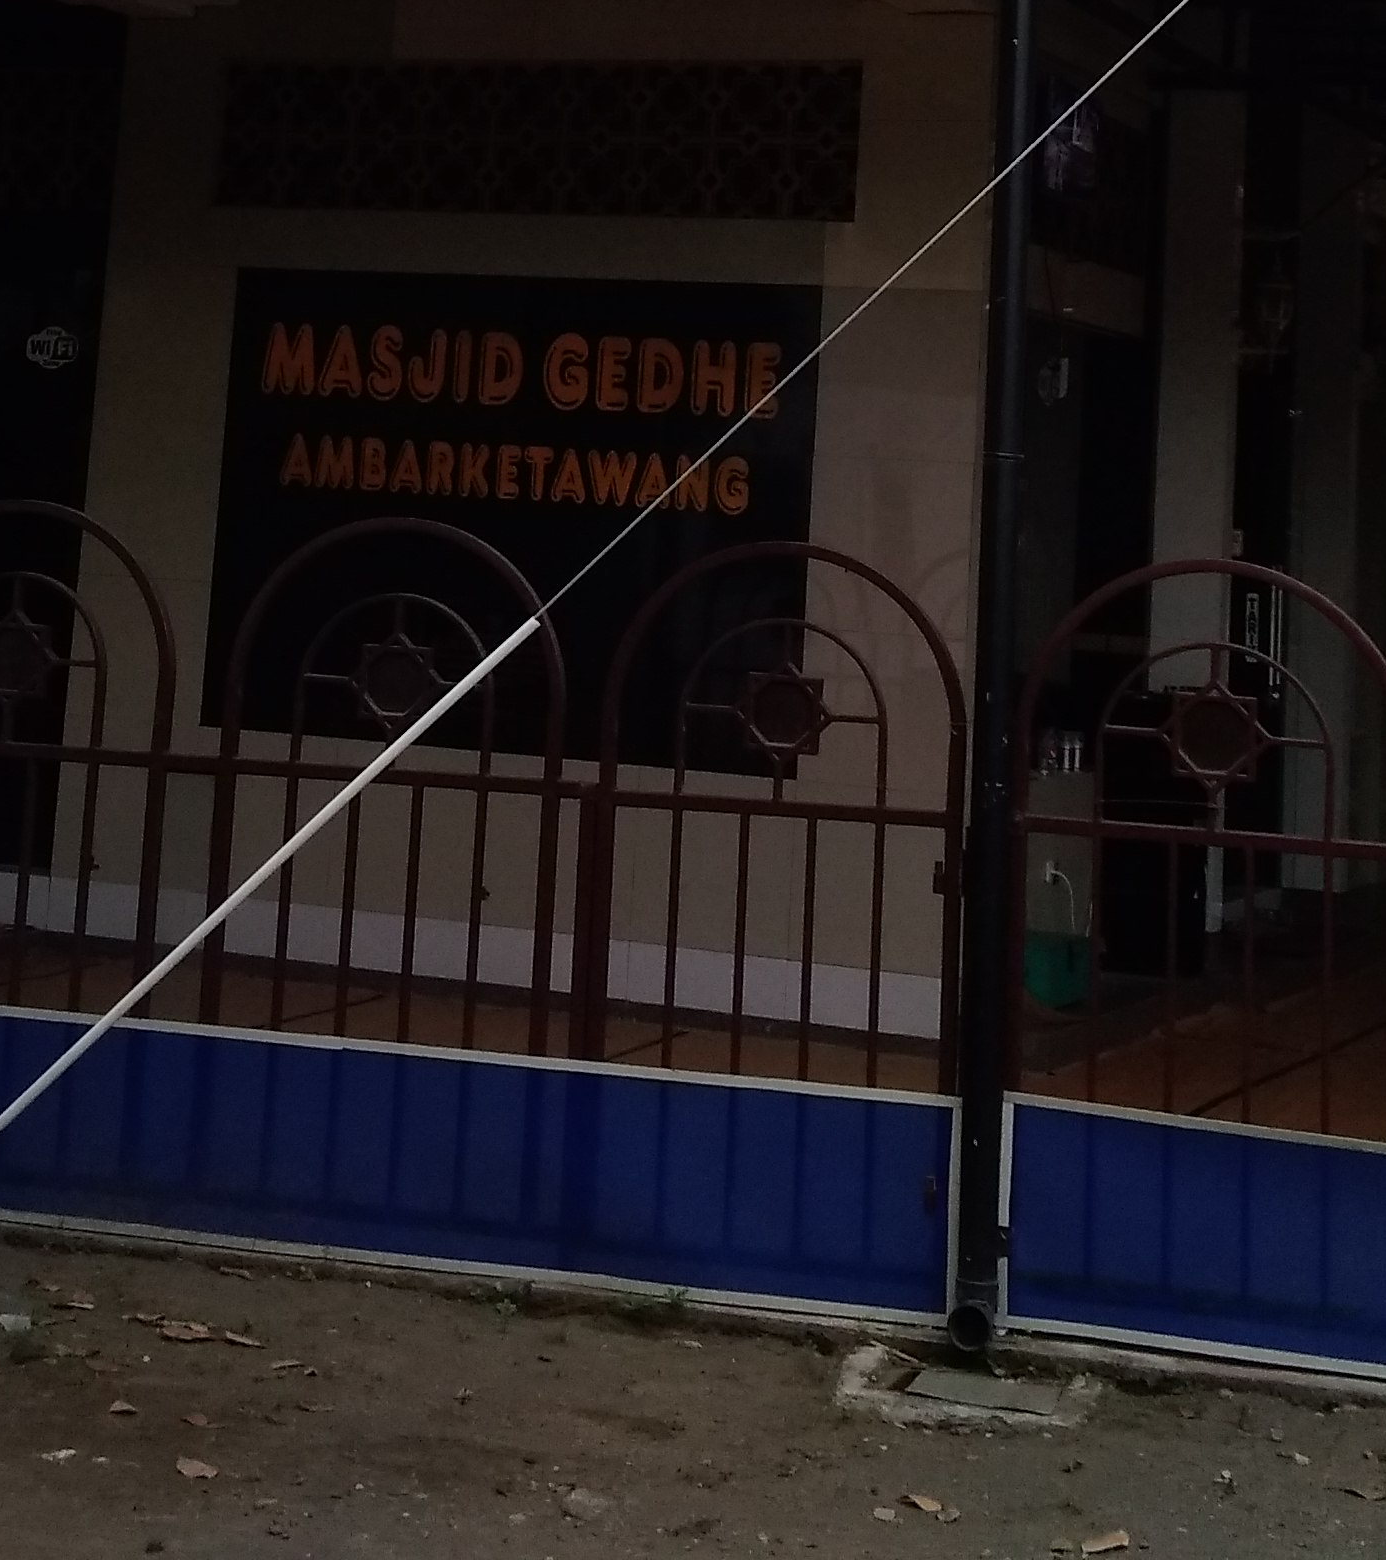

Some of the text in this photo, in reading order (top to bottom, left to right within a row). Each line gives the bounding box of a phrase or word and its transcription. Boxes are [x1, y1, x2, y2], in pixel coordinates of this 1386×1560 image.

[260, 321, 784, 422] MASJID GEDHE
[278, 431, 752, 517] AMBARKETAWANG
